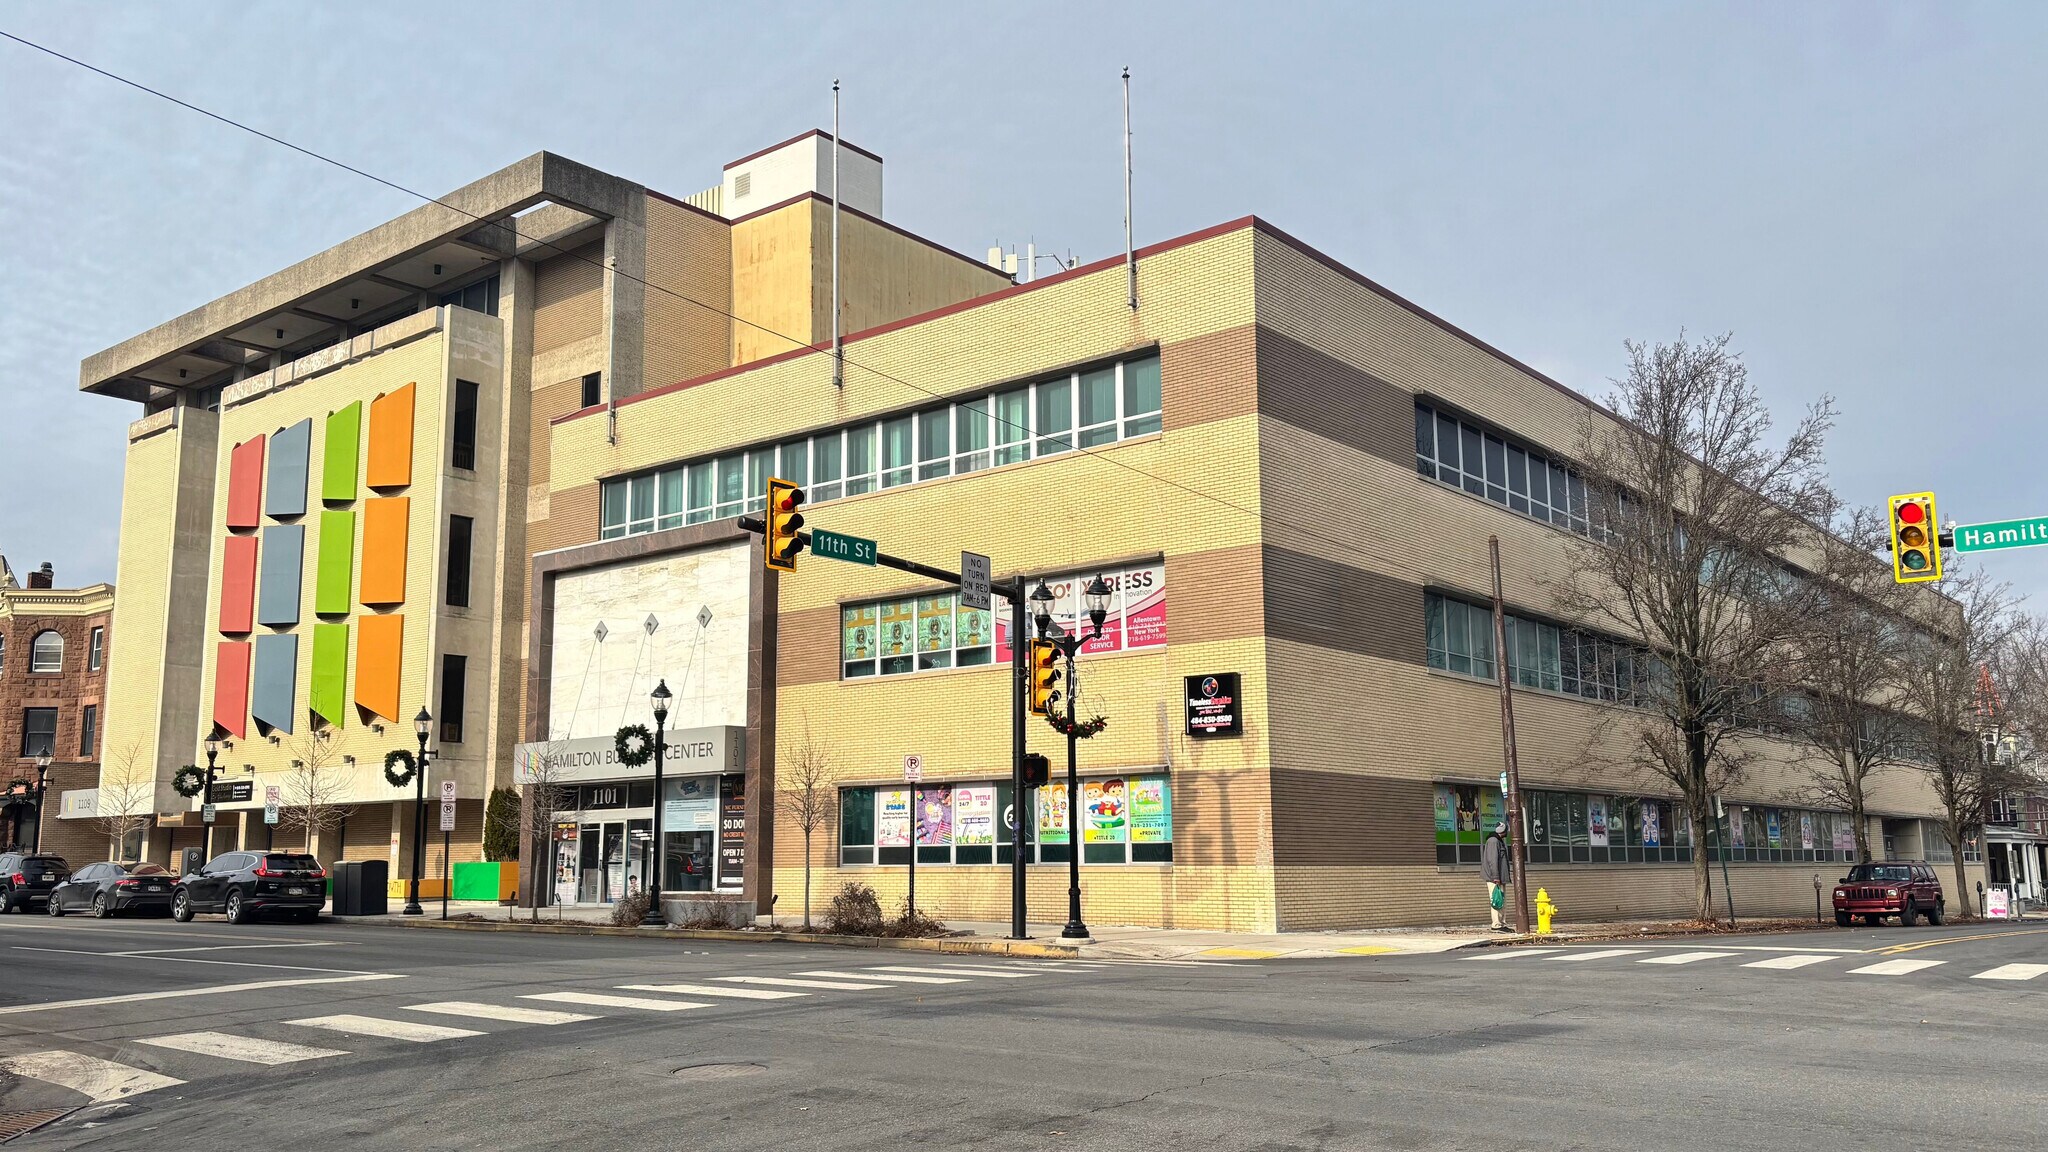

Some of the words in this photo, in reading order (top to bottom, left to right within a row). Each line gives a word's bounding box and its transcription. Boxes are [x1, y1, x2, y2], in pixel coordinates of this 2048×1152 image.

[819, 535, 848, 554] 11th
[855, 543, 870, 559] St
[970, 558, 982, 568] NO
[968, 569, 985, 581] TURN
[964, 580, 973, 591] ON
[976, 582, 989, 594] RED
[1081, 570, 1153, 596] XRESS
[1133, 616, 1162, 624] Allentown
[1128, 633, 1167, 643] 718-619-7599
[1090, 641, 1114, 650] SERVICE
[664, 741, 714, 760] CENTER
[592, 788, 618, 805] 1101
[78, 799, 91, 809] 1109
[723, 848, 737, 856] OPEN
